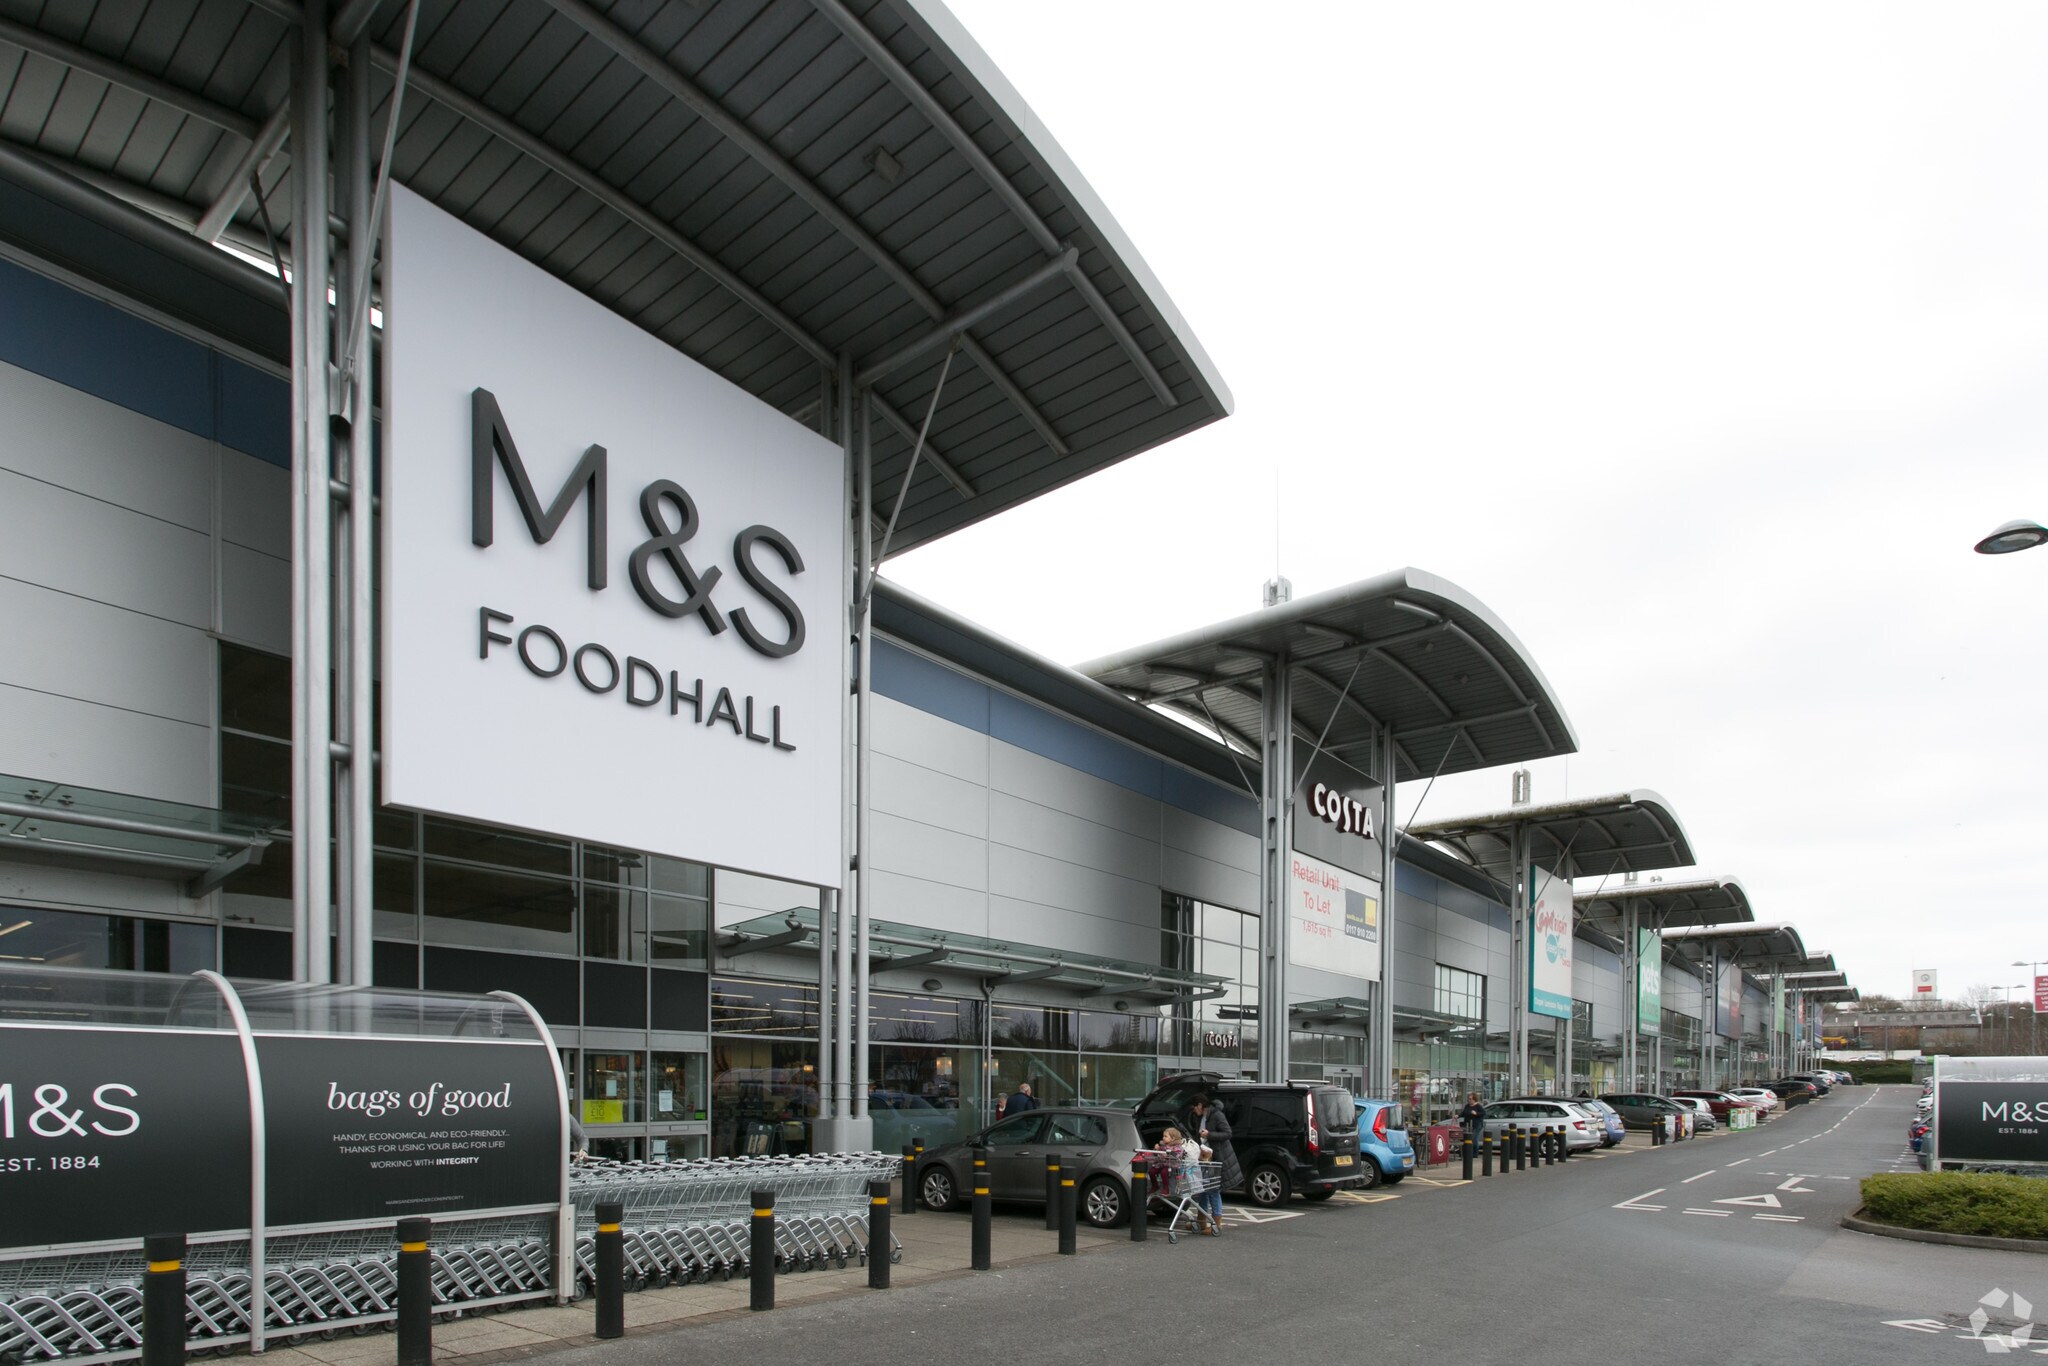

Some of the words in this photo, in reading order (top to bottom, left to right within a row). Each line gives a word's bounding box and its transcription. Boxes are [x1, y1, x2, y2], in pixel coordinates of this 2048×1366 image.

[471, 386, 806, 659] M&S
[479, 606, 797, 752] FOODHALL
[1310, 782, 1375, 840] COSTA
[1292, 860, 1320, 885] Retail
[1322, 871, 1340, 892] Unit
[1303, 890, 1314, 910] To
[1316, 894, 1331, 915] Let
[1319, 926, 1327, 938] sq
[1345, 923, 1357, 936] 0117
[1641, 962, 1660, 997] pets
[1208, 1033, 1239, 1049] COSTA
[0, 1083, 140, 1138] &S
[326, 1081, 401, 1118] bags
[408, 1081, 444, 1117] of
[441, 1082, 512, 1117] good
[1982, 1101, 2048, 1122] M&S
[333, 1133, 368, 1142] HANDY,
[369, 1131, 428, 1141] ECONOMICAL
[429, 1131, 448, 1139] AND
[339, 1145, 376, 1154] THANKS
[378, 1144, 396, 1152] FOR
[398, 1143, 425, 1152] USING
[427, 1142, 450, 1150] YOUR
[452, 1141, 469, 1149] BAG
[488, 1140, 506, 1148] LIFE!
[50, 1155, 101, 1170] 1884
[370, 1159, 412, 1169] WORKING
[413, 1158, 434, 1167] WITH
[436, 1156, 480, 1166] INTEGRITY
